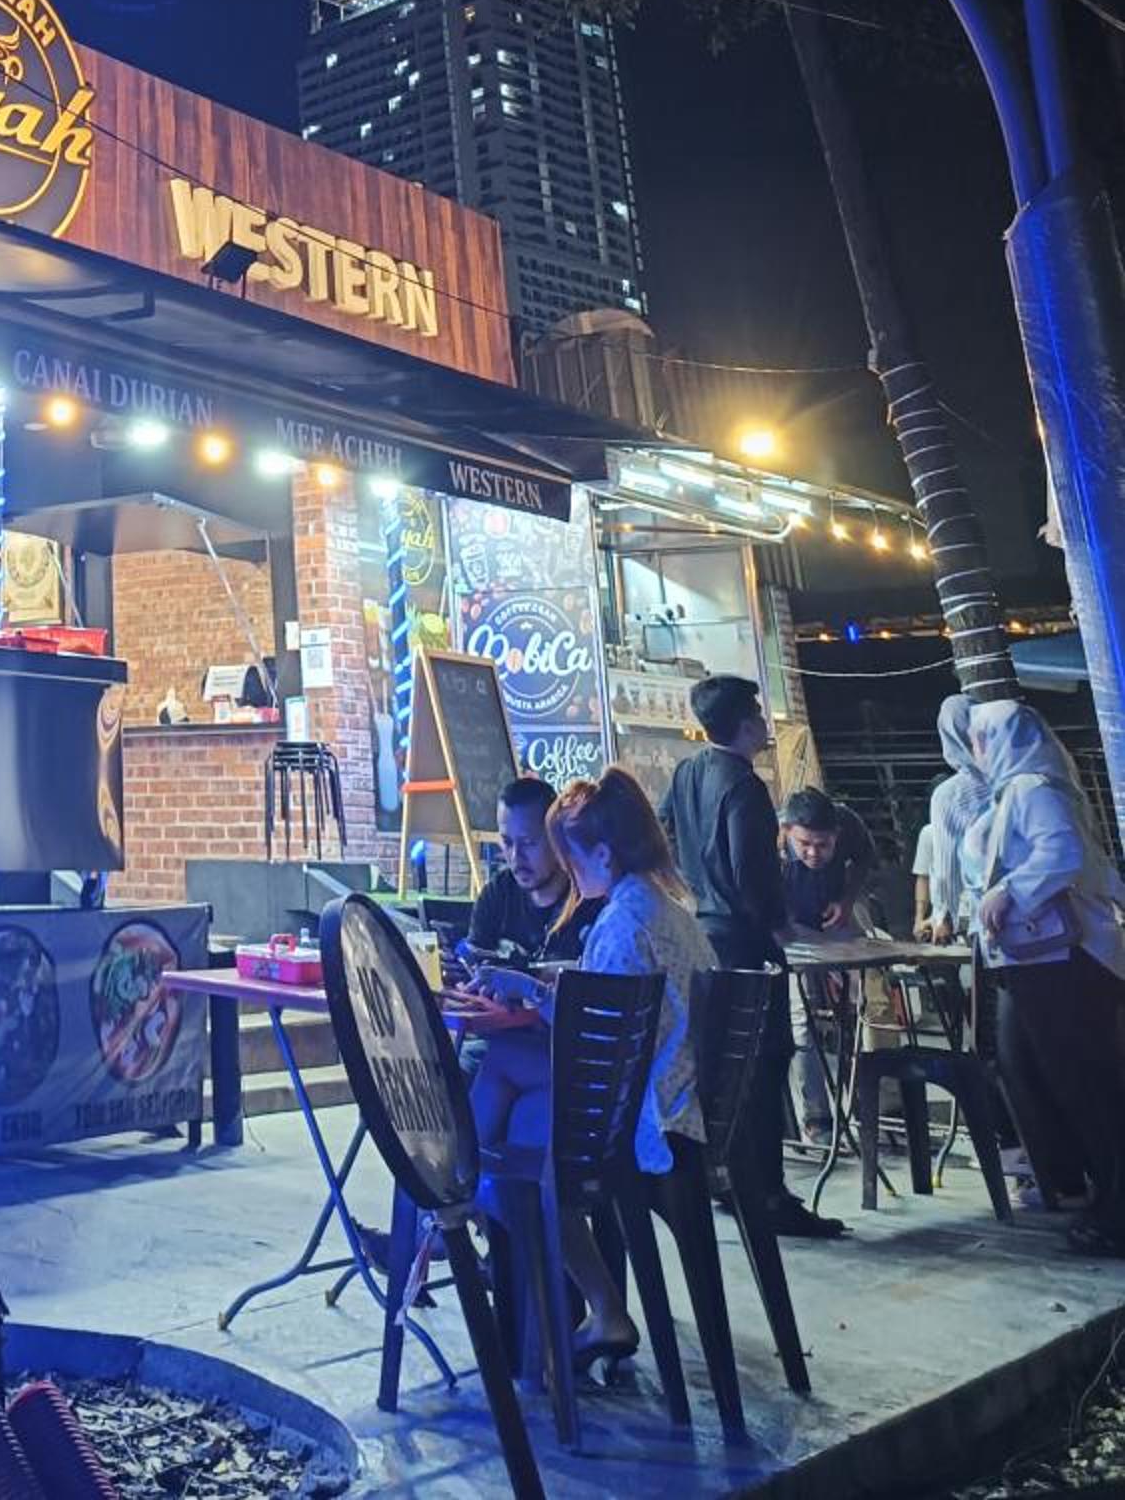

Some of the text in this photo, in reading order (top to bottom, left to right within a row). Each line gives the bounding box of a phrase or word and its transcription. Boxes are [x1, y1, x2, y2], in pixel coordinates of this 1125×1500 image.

[170, 178, 439, 337] WESTERN
[13, 350, 213, 426] CANAI DURIAN
[448, 461, 542, 510] WESTERN
[527, 733, 603, 775] Coffee
